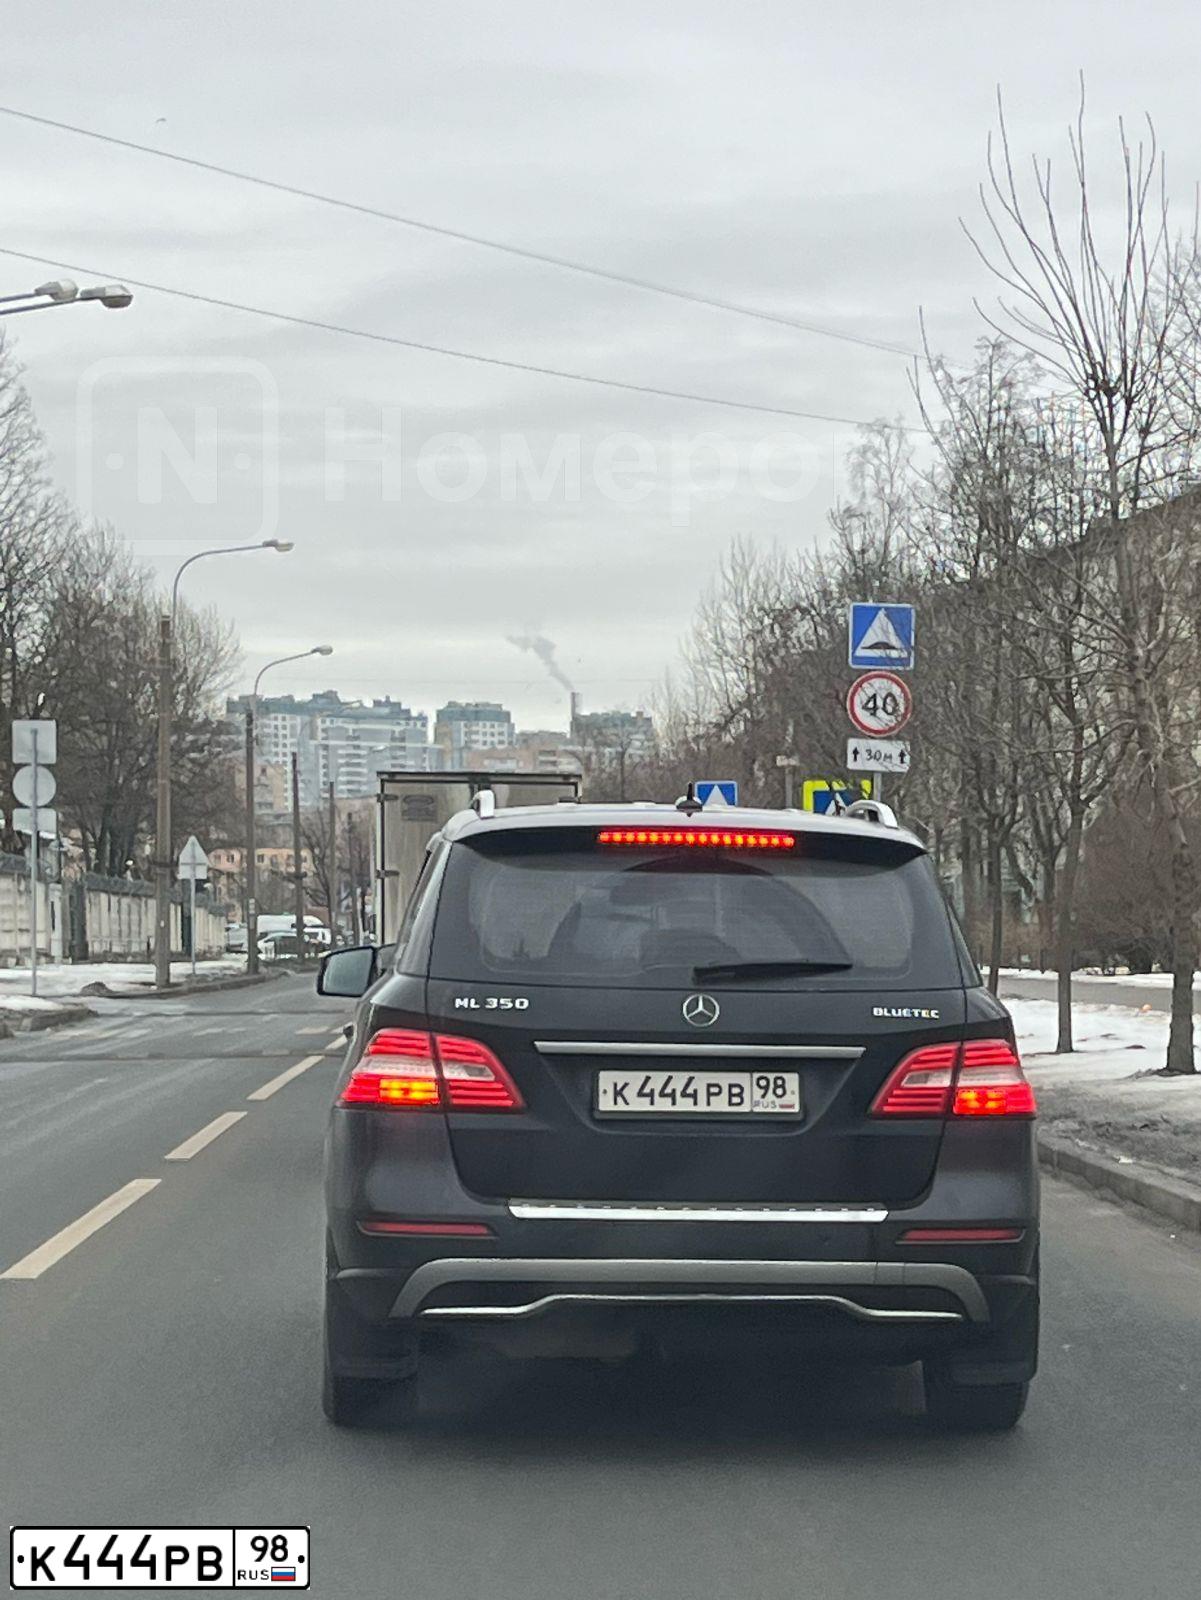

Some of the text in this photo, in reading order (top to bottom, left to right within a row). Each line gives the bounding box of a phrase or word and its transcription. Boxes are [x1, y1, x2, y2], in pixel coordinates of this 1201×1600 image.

[861, 692, 898, 716] 40
[454, 997, 529, 1010] ML 350
[872, 1007, 940, 1019] BLUETEC
[756, 1075, 787, 1099] 98
[753, 1100, 777, 1109] RUS
